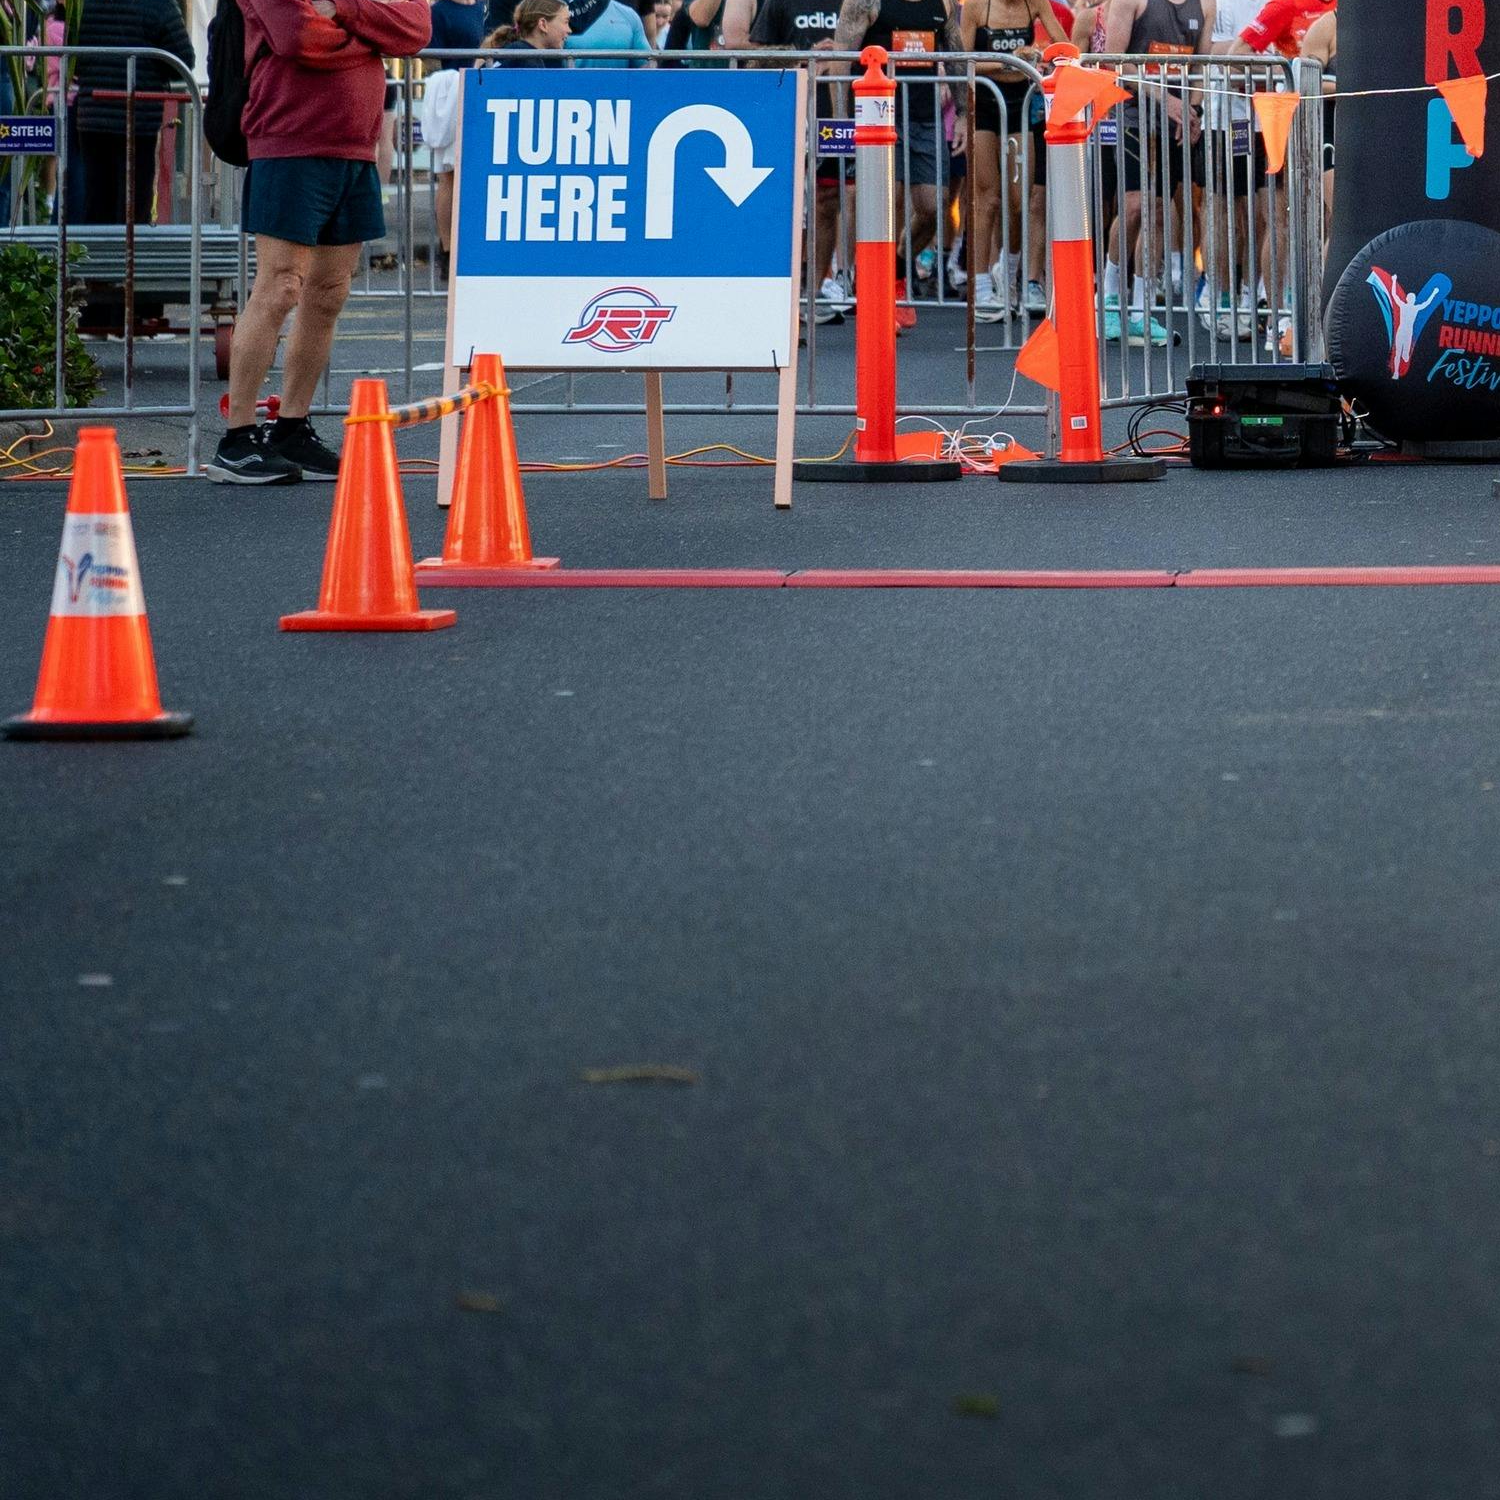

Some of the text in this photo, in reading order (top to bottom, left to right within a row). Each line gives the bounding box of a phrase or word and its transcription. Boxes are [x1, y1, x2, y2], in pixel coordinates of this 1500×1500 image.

[795, 11, 839, 29] adid
[992, 38, 1025, 51] 6069
[486, 99, 631, 166] TURN
[485, 175, 628, 242] HERE
[562, 305, 678, 344] JRT
